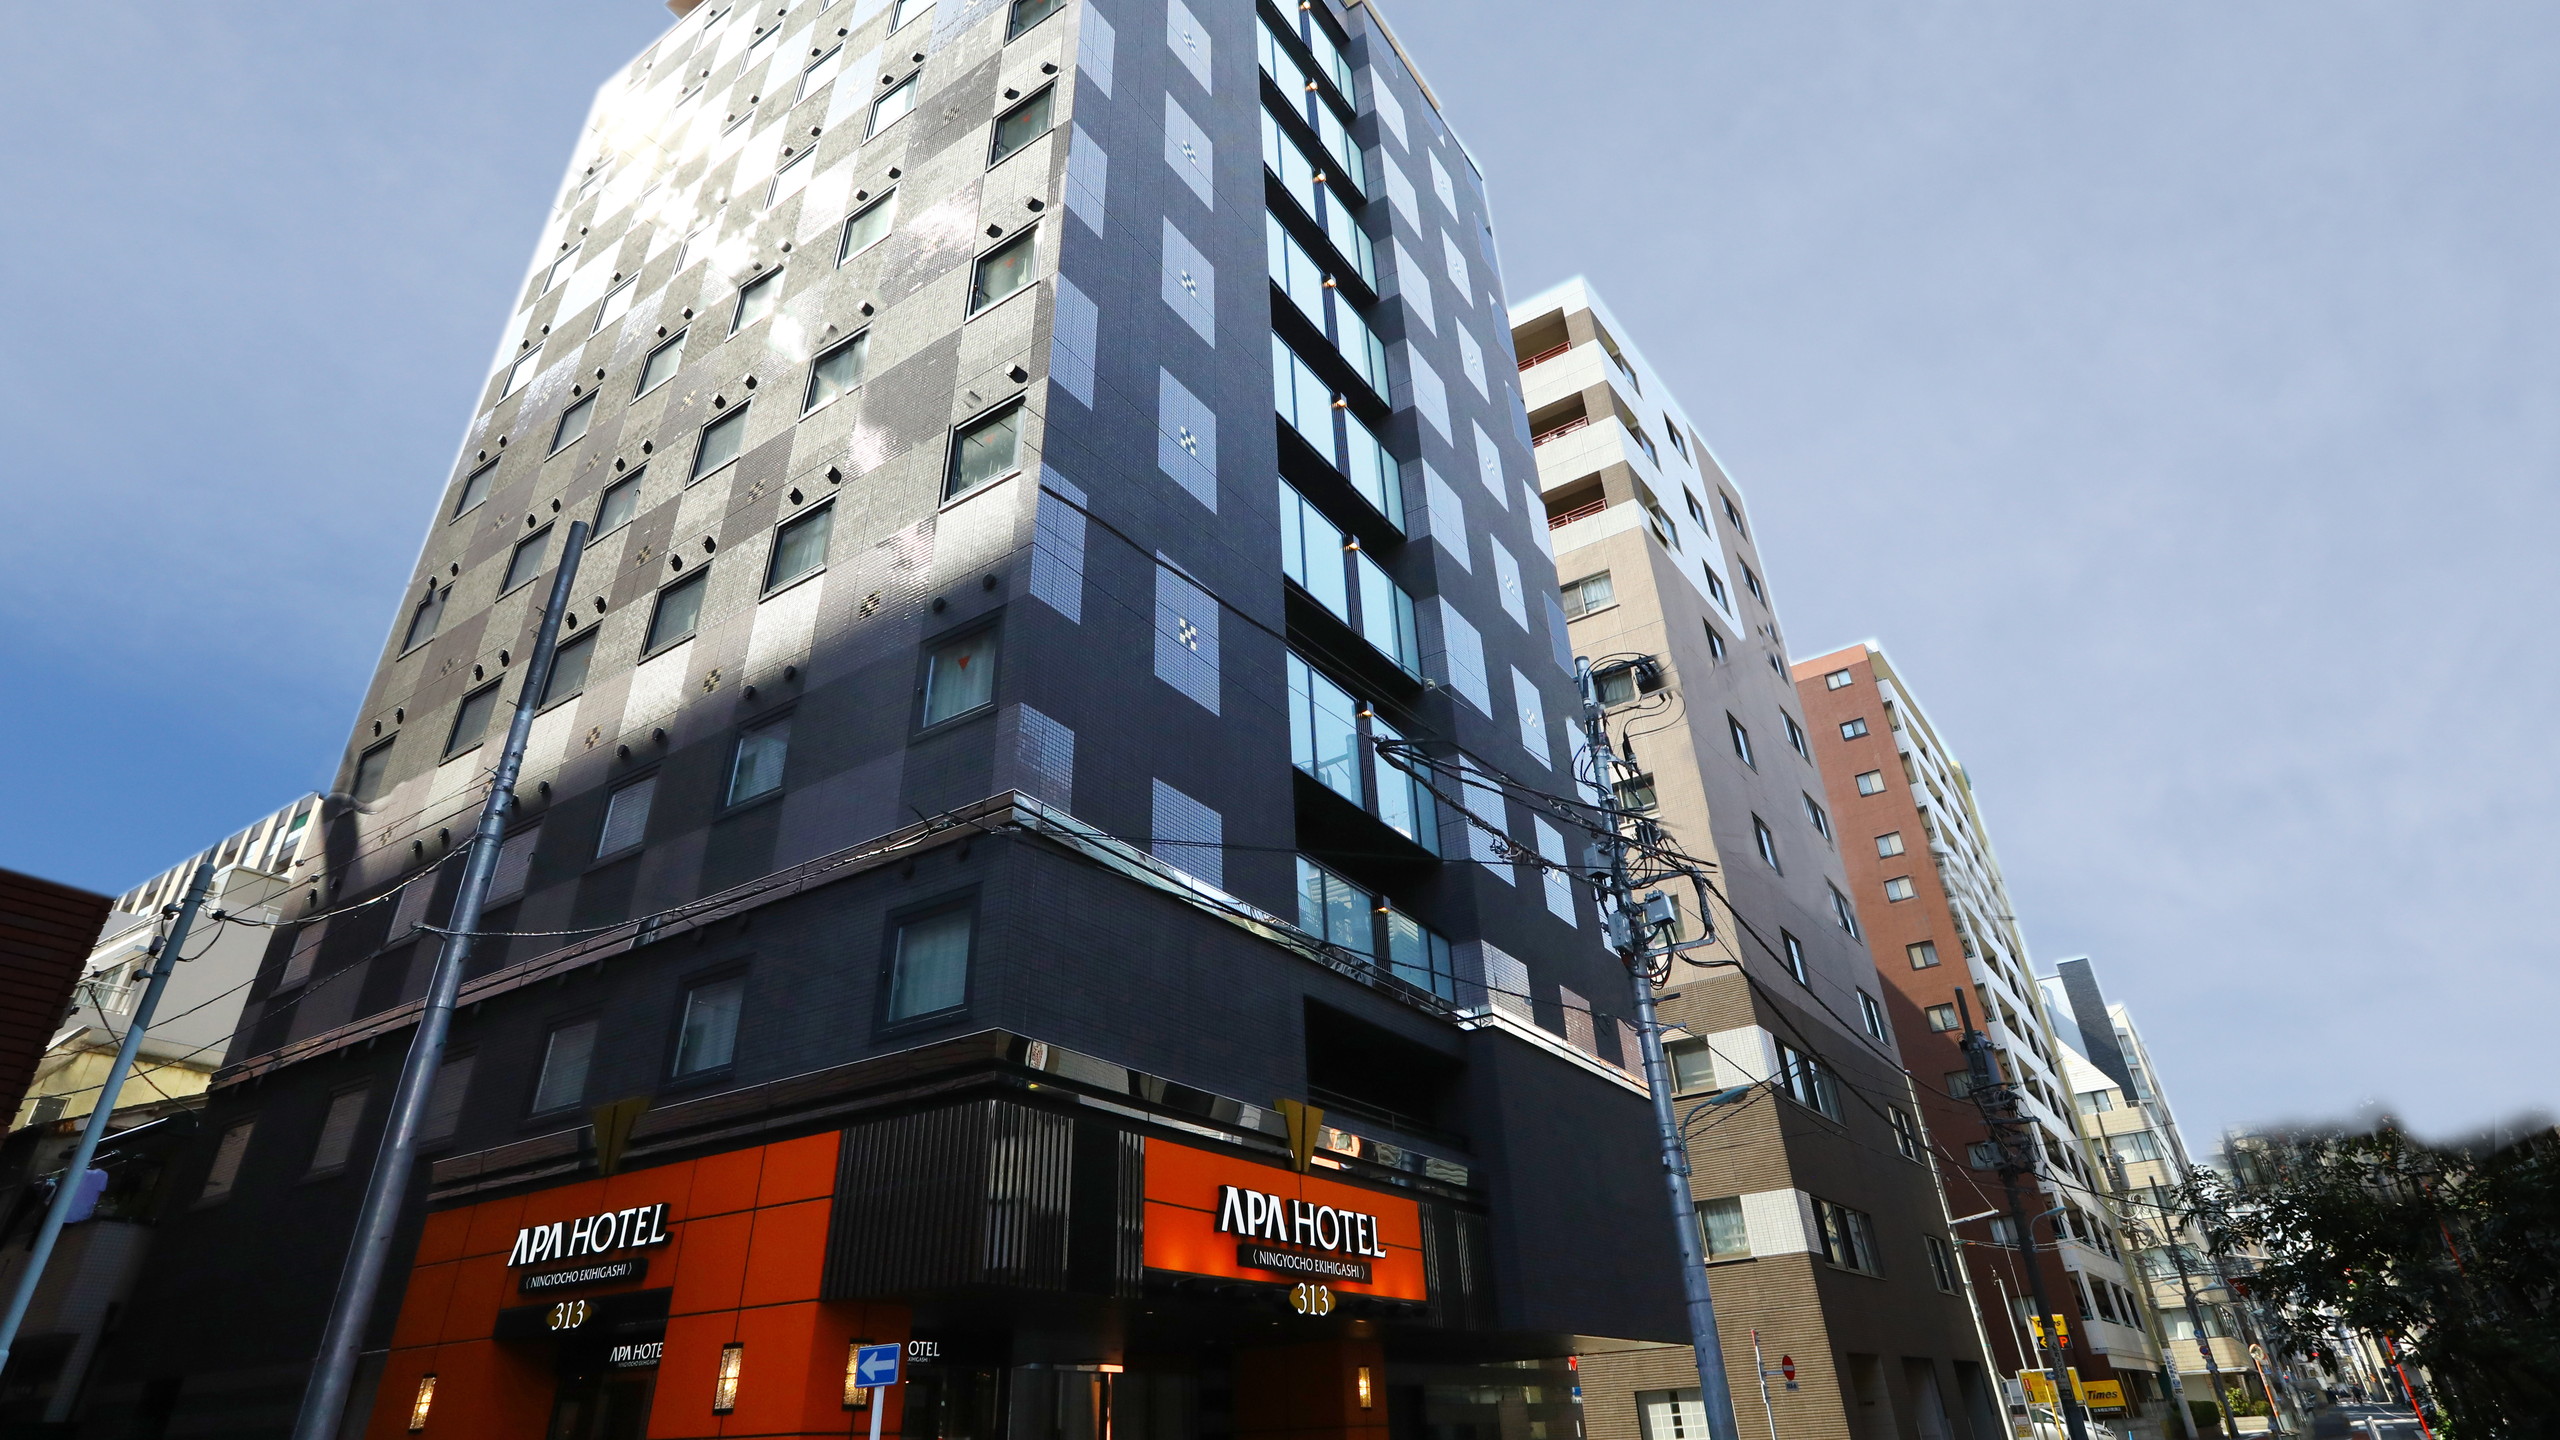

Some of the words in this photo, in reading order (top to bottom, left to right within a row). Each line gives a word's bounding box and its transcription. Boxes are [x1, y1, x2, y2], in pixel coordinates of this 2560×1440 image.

[507, 1221, 563, 1267] APA
[567, 1203, 666, 1257] HOTEL
[1221, 1185, 1288, 1242] APA
[1293, 1199, 1387, 1258] HOTEL
[1297, 1282, 1329, 1317] 313
[551, 1300, 586, 1331] 313
[609, 1345, 632, 1362] APA
[633, 1342, 664, 1361] HOTE
[908, 1340, 940, 1357] OTEL
[2087, 1390, 2118, 1400] Times
